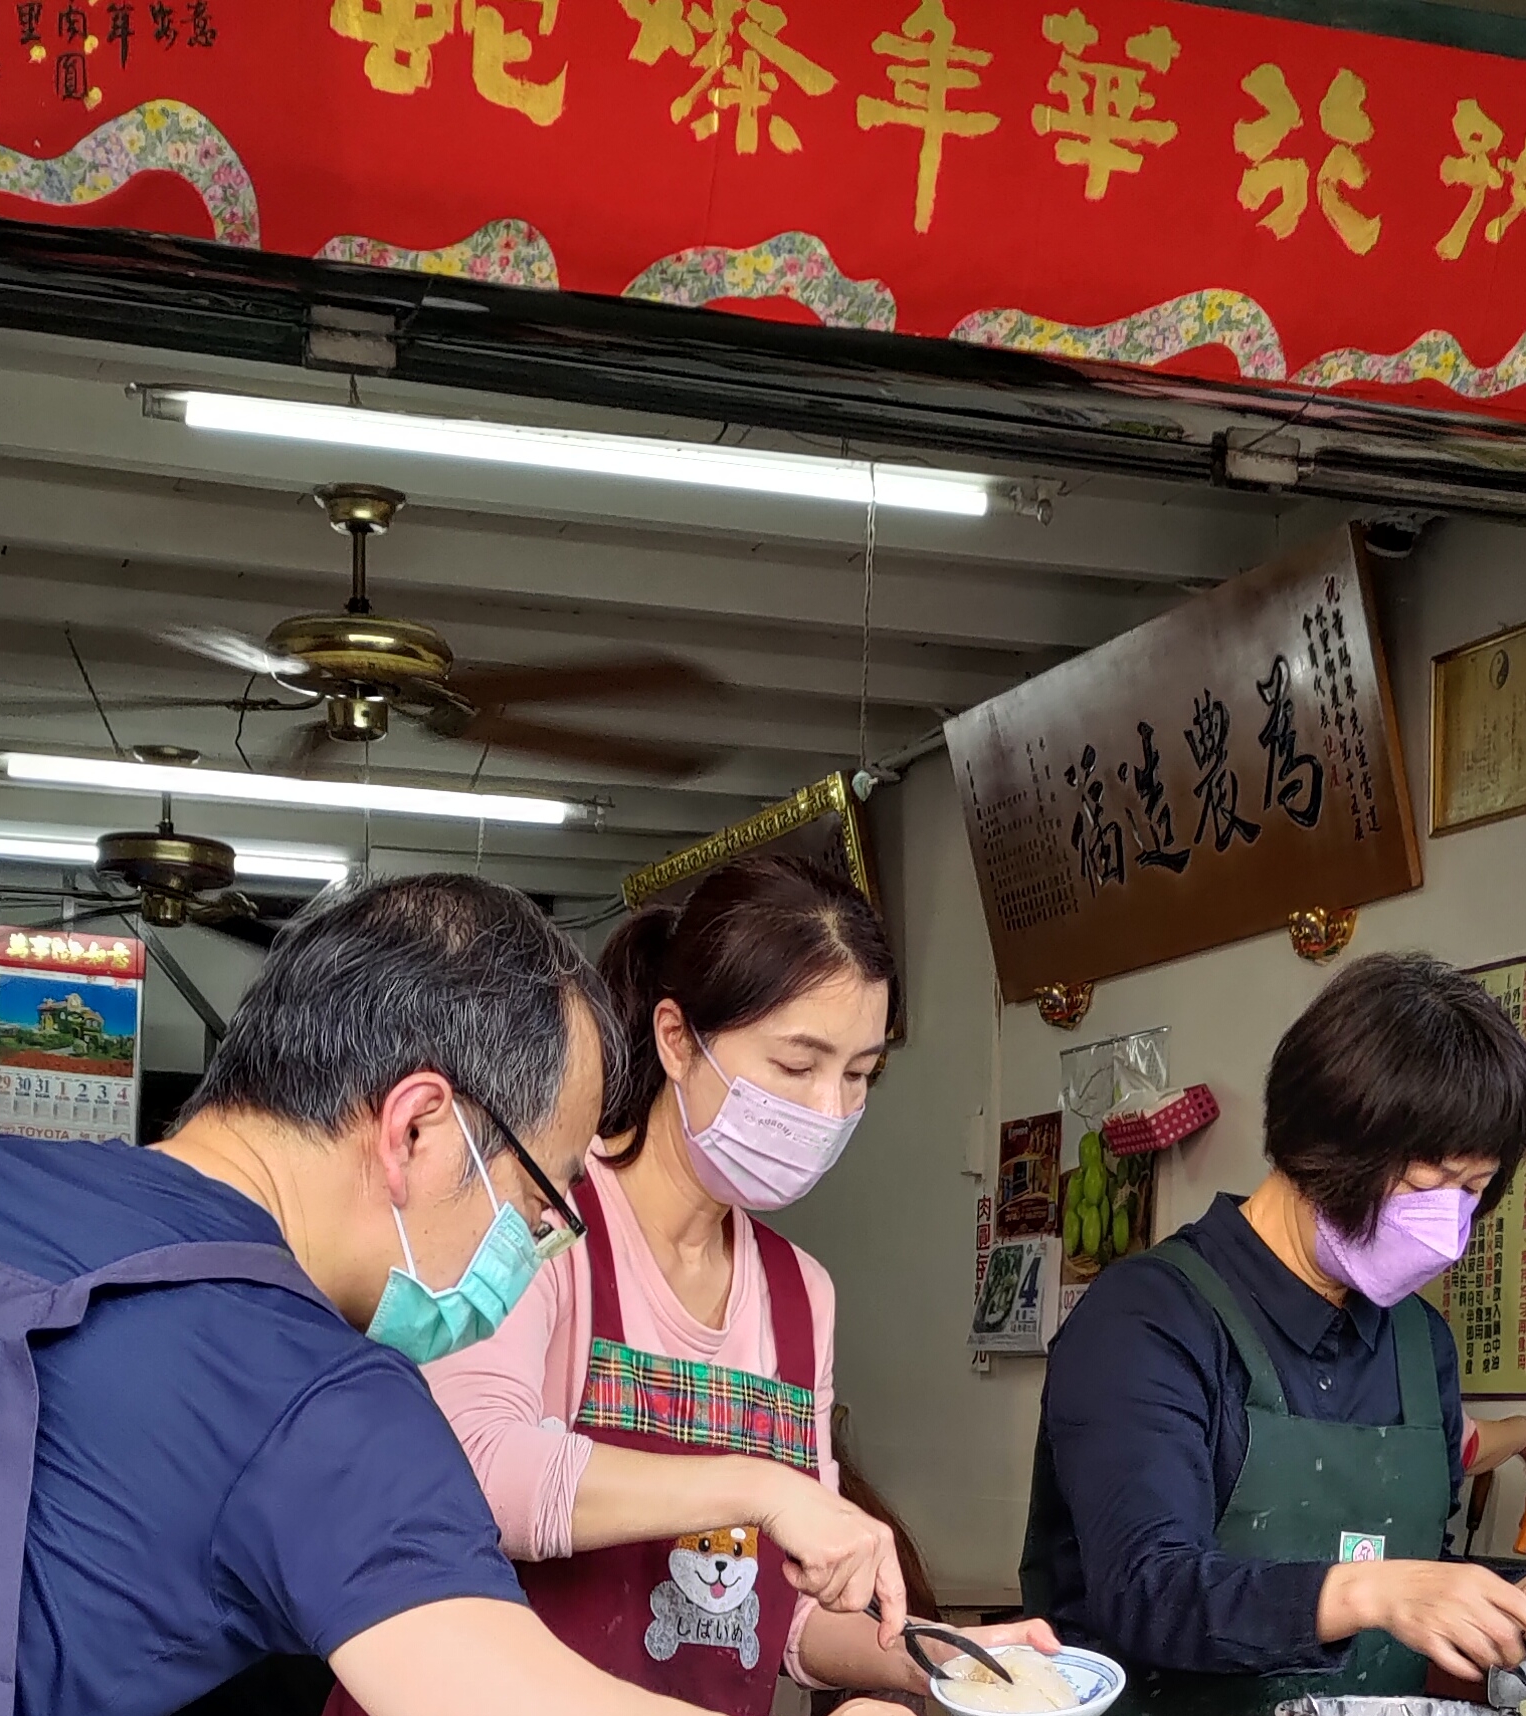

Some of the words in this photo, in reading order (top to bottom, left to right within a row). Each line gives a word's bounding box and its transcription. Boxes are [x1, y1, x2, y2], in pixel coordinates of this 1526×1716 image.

[15, 1076, 32, 1092] 30
[35, 1078, 51, 1094] 31
[59, 1081, 68, 1097] 1
[77, 1084, 88, 1098] 2
[97, 1085, 108, 1100] 3
[116, 1087, 128, 1102] 4
[18, 1125, 71, 1141] TOYOTA
[1018, 1256, 1042, 1309] 4
